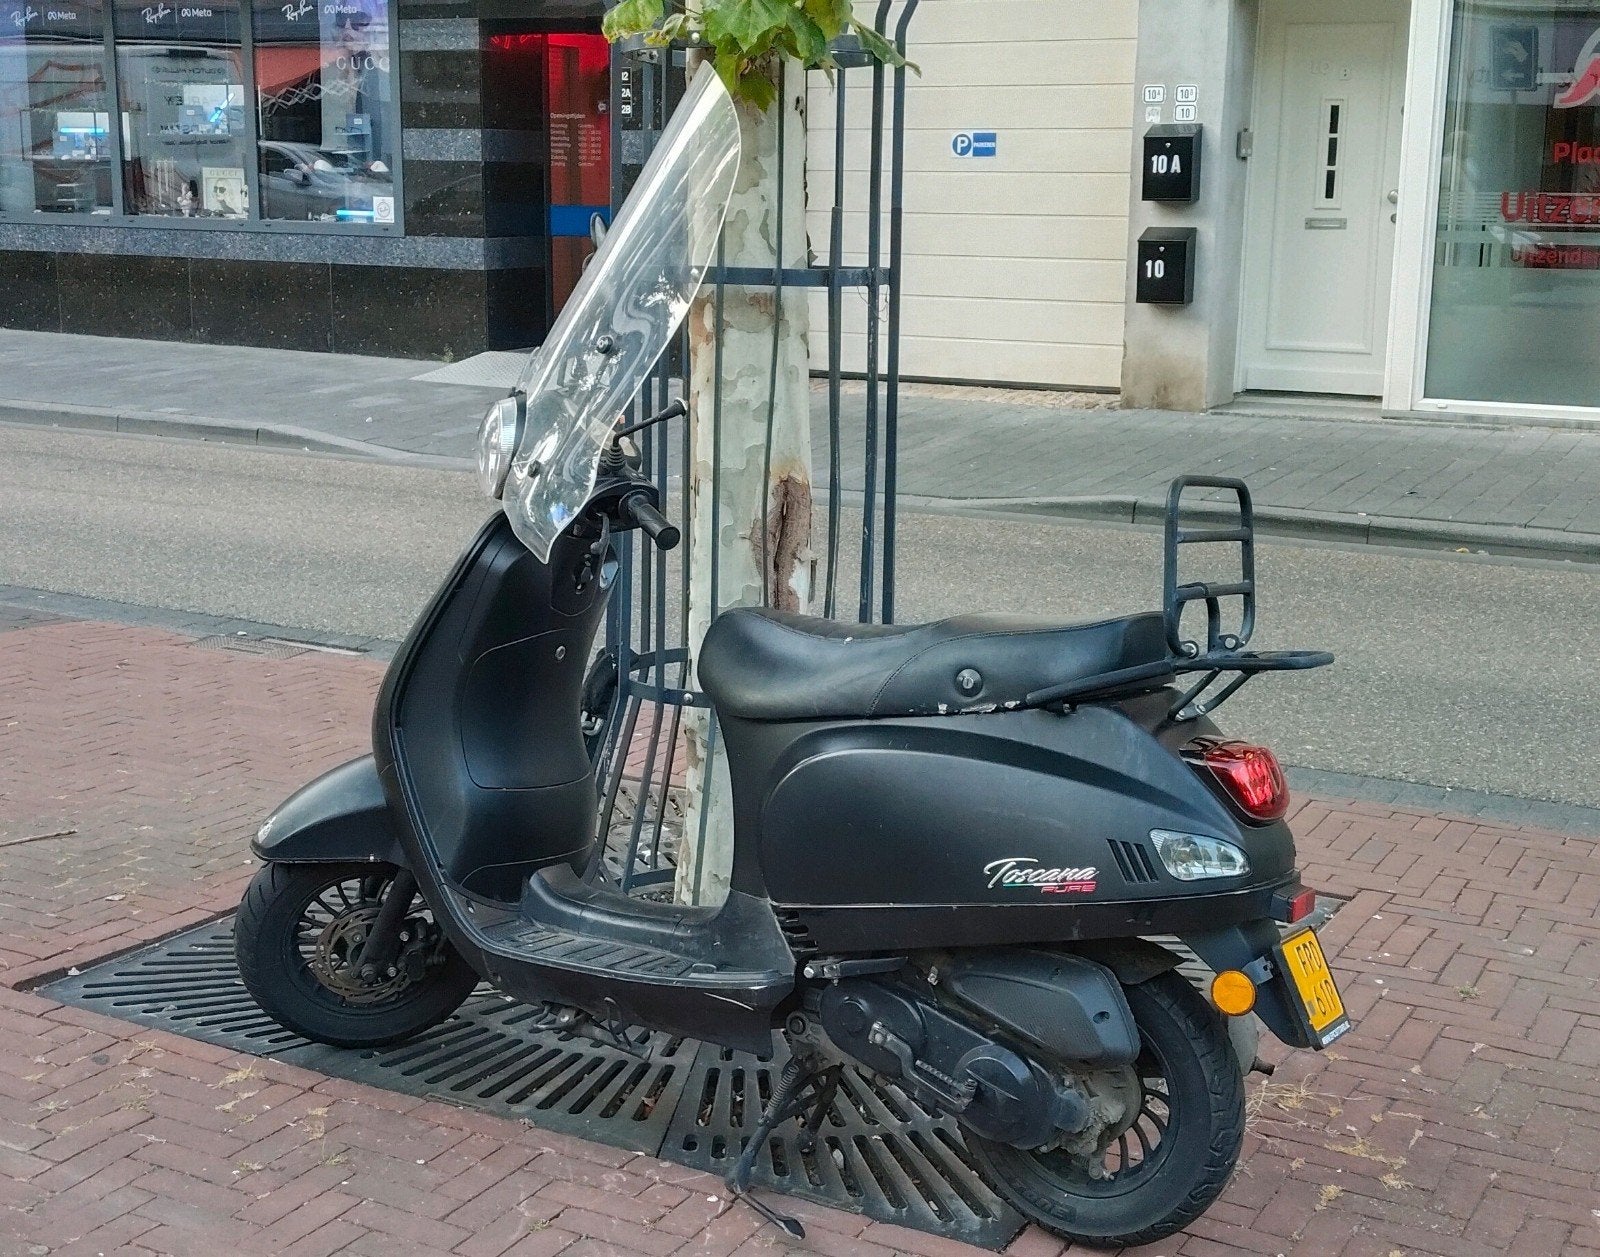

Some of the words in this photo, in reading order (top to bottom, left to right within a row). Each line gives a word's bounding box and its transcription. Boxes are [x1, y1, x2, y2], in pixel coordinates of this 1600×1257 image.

[58, 11, 76, 20] Meta
[192, 8, 212, 17] Meta
[336, 5, 357, 14] Meta
[1181, 108, 1190, 119] 10
[956, 136, 969, 154] P
[1151, 154, 1168, 174] 10
[1170, 154, 1181, 174] A
[1145, 259, 1165, 278] 10
[983, 857, 1100, 889] Toscana
[1294, 940, 1322, 978] FPD
[1313, 979, 1337, 1016] 61P
